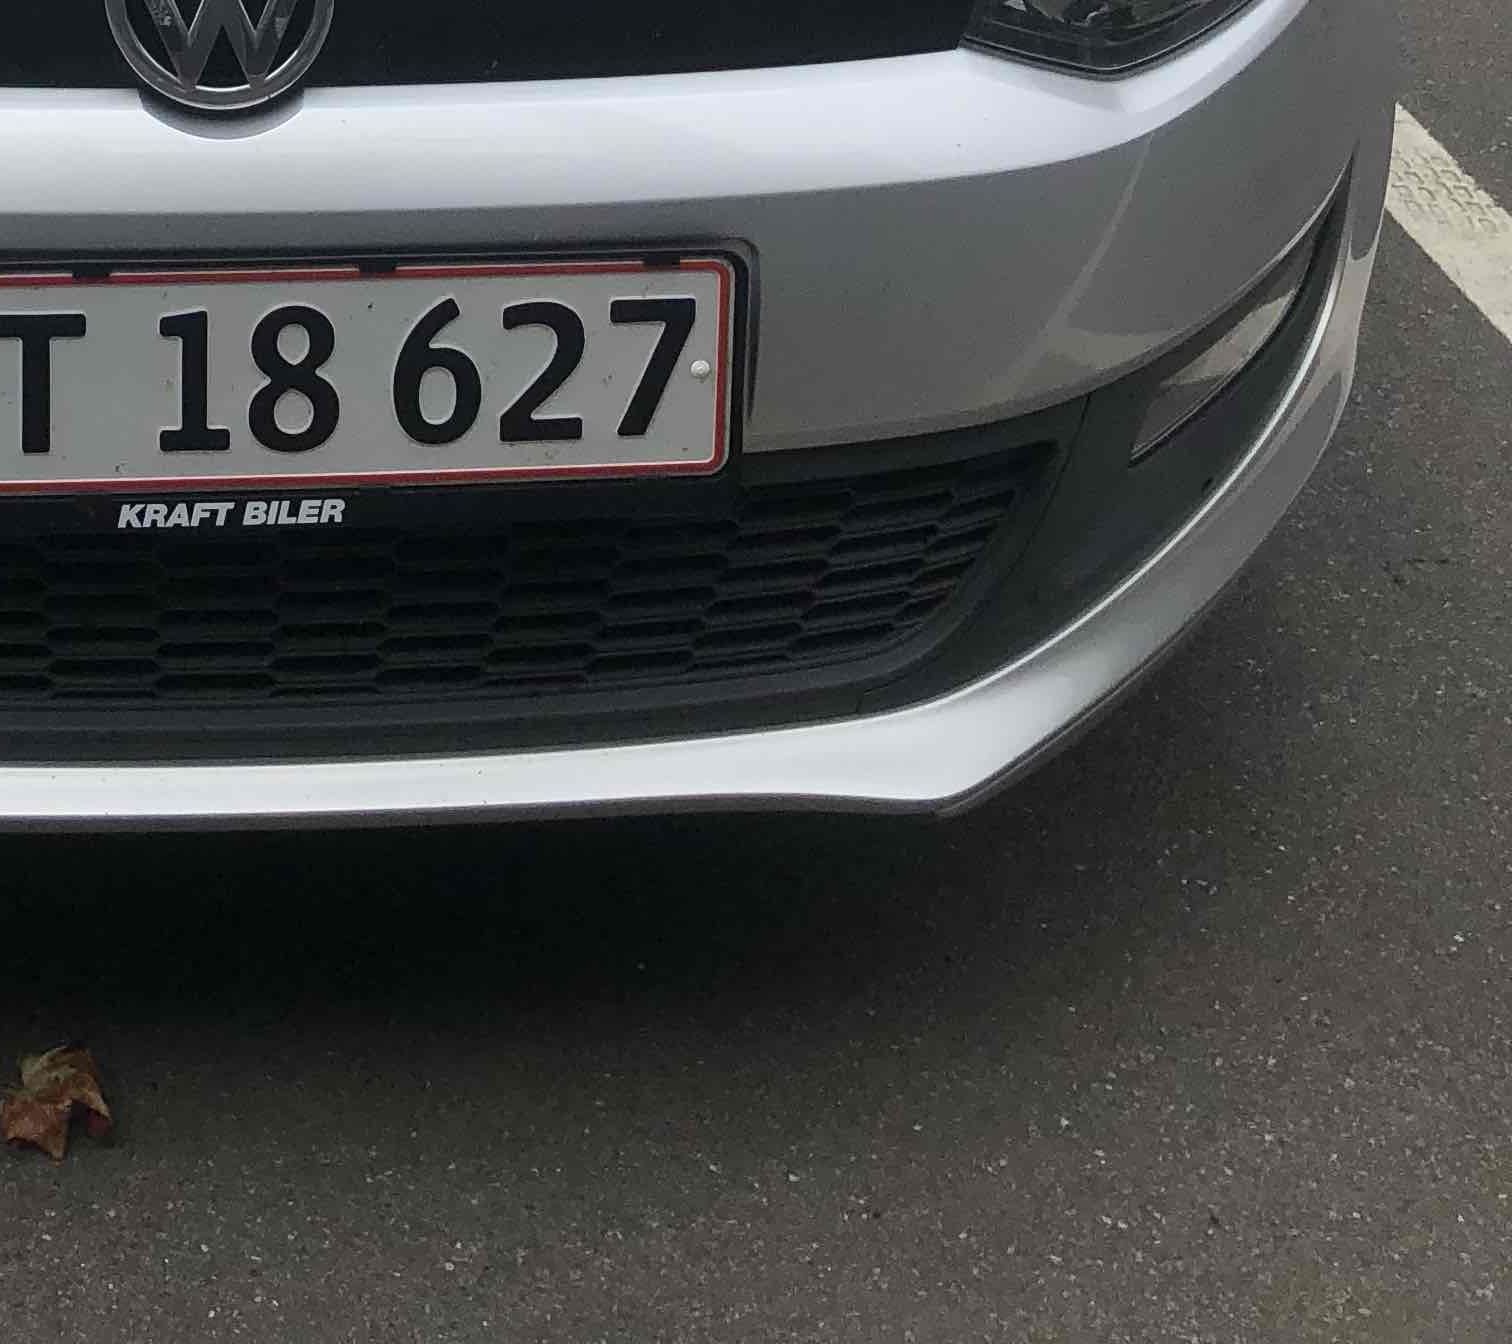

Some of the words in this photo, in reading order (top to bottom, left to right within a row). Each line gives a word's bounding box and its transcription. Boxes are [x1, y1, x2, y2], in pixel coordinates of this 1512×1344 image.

[158, 304, 341, 453] 18
[392, 297, 697, 444] 627
[117, 501, 236, 529] KRAFT
[242, 498, 346, 526] BILER
